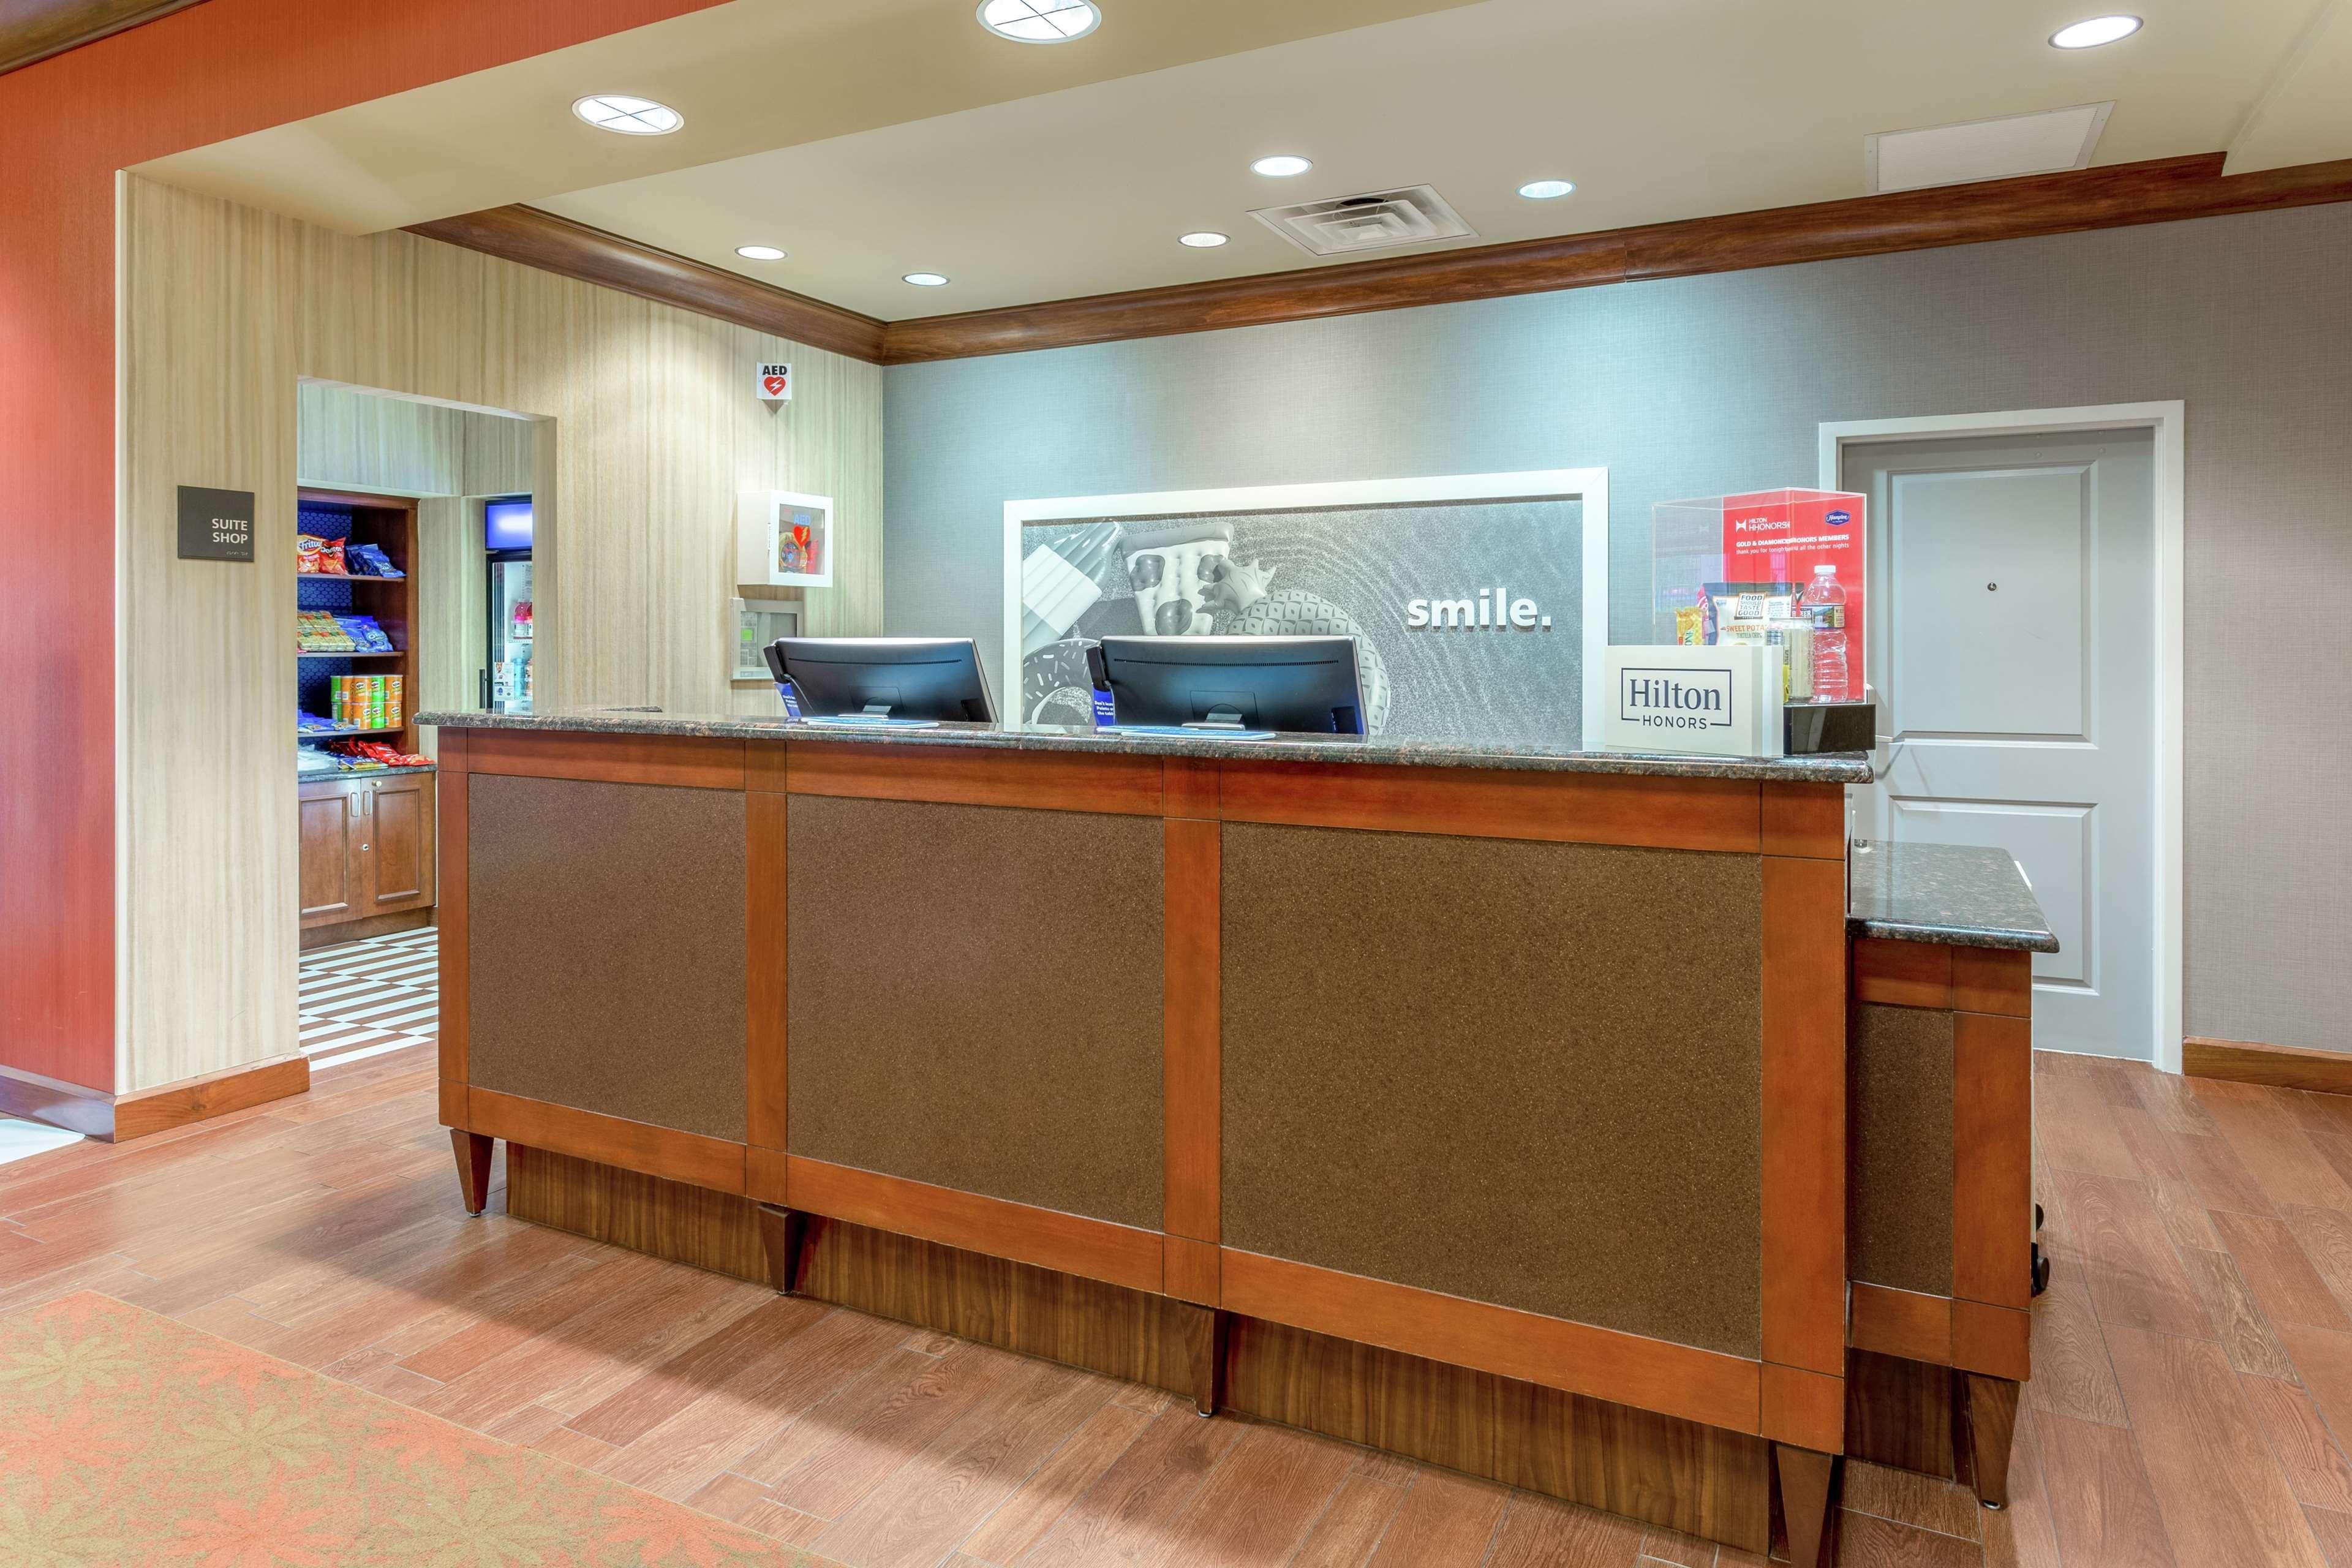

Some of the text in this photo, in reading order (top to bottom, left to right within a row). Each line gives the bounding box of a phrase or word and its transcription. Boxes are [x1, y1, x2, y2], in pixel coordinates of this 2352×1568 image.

[762, 365, 788, 375] AED
[211, 518, 248, 531] SUITE
[794, 514, 811, 526] AED
[213, 532, 248, 544] SHOP
[1407, 587, 1551, 627] smile.
[1629, 679, 1722, 711] Hilton
[1643, 715, 1708, 730] HONORS
